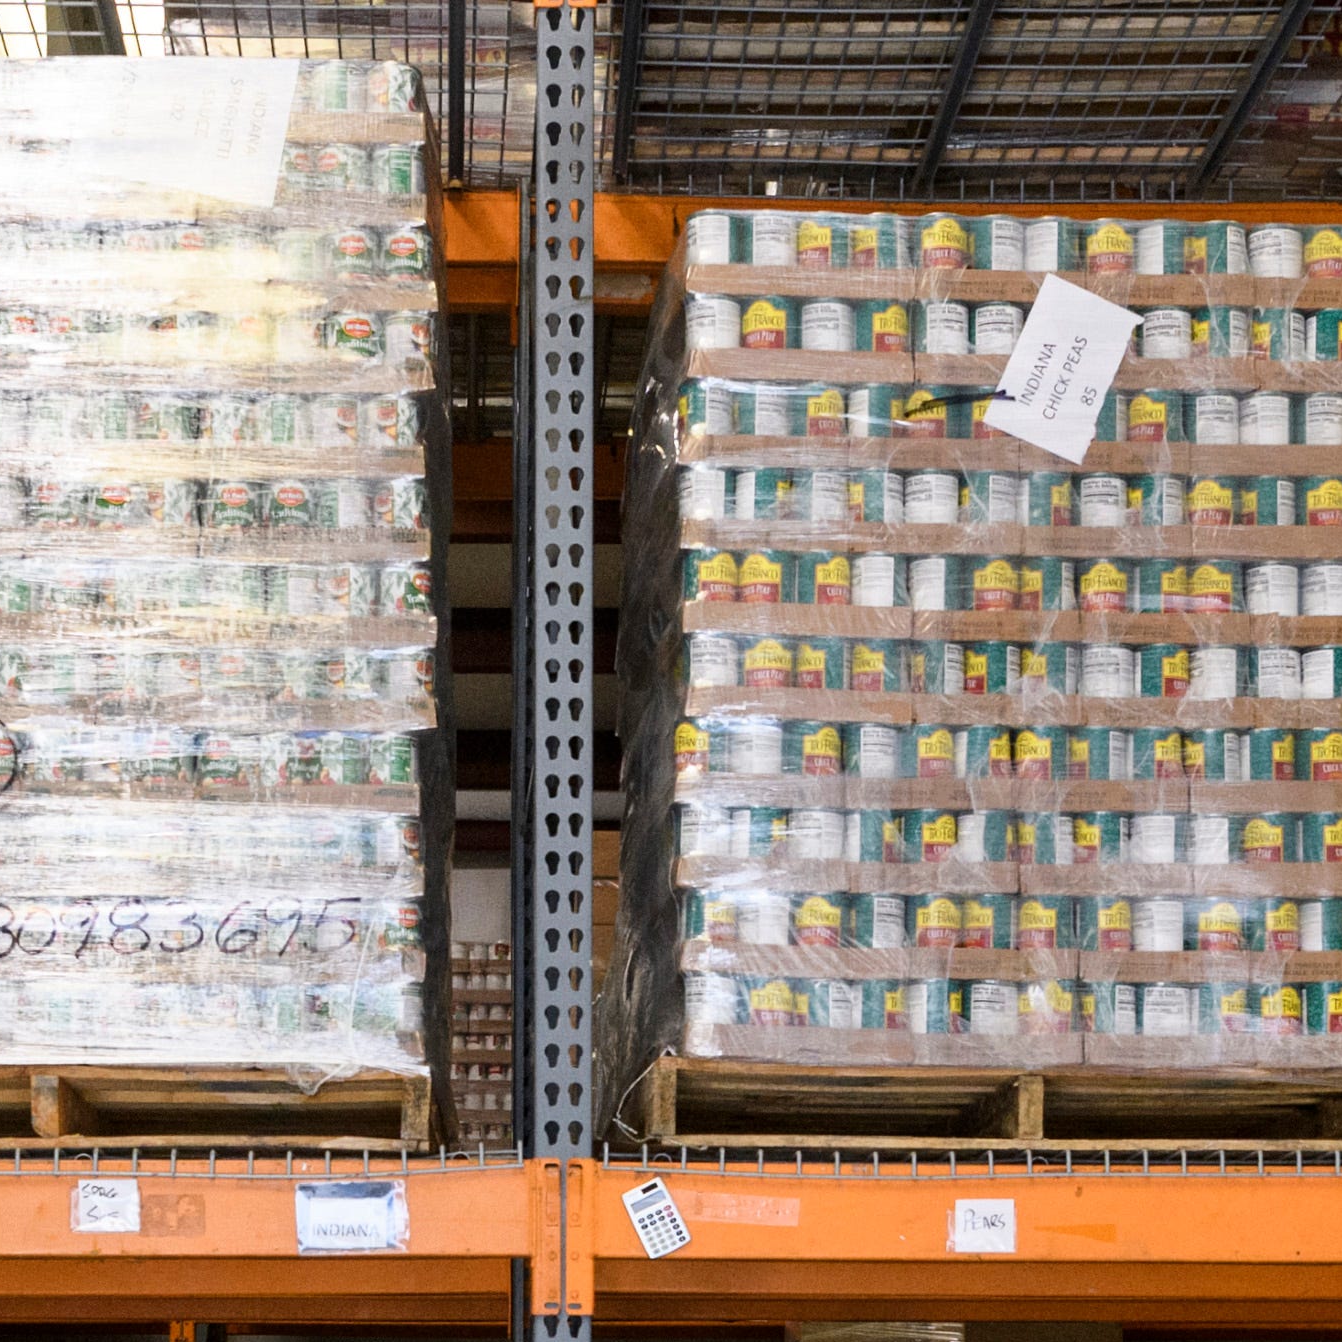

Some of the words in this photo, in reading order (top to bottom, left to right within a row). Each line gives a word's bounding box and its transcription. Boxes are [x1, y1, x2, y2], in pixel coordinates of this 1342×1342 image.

[1019, 343, 1056, 406] INDIANA
[1042, 374, 1070, 420] CHICK
[1065, 336, 1087, 373] PEAS
[1080, 386, 1097, 406] 85
[313, 1224, 380, 1238] INDIANA
